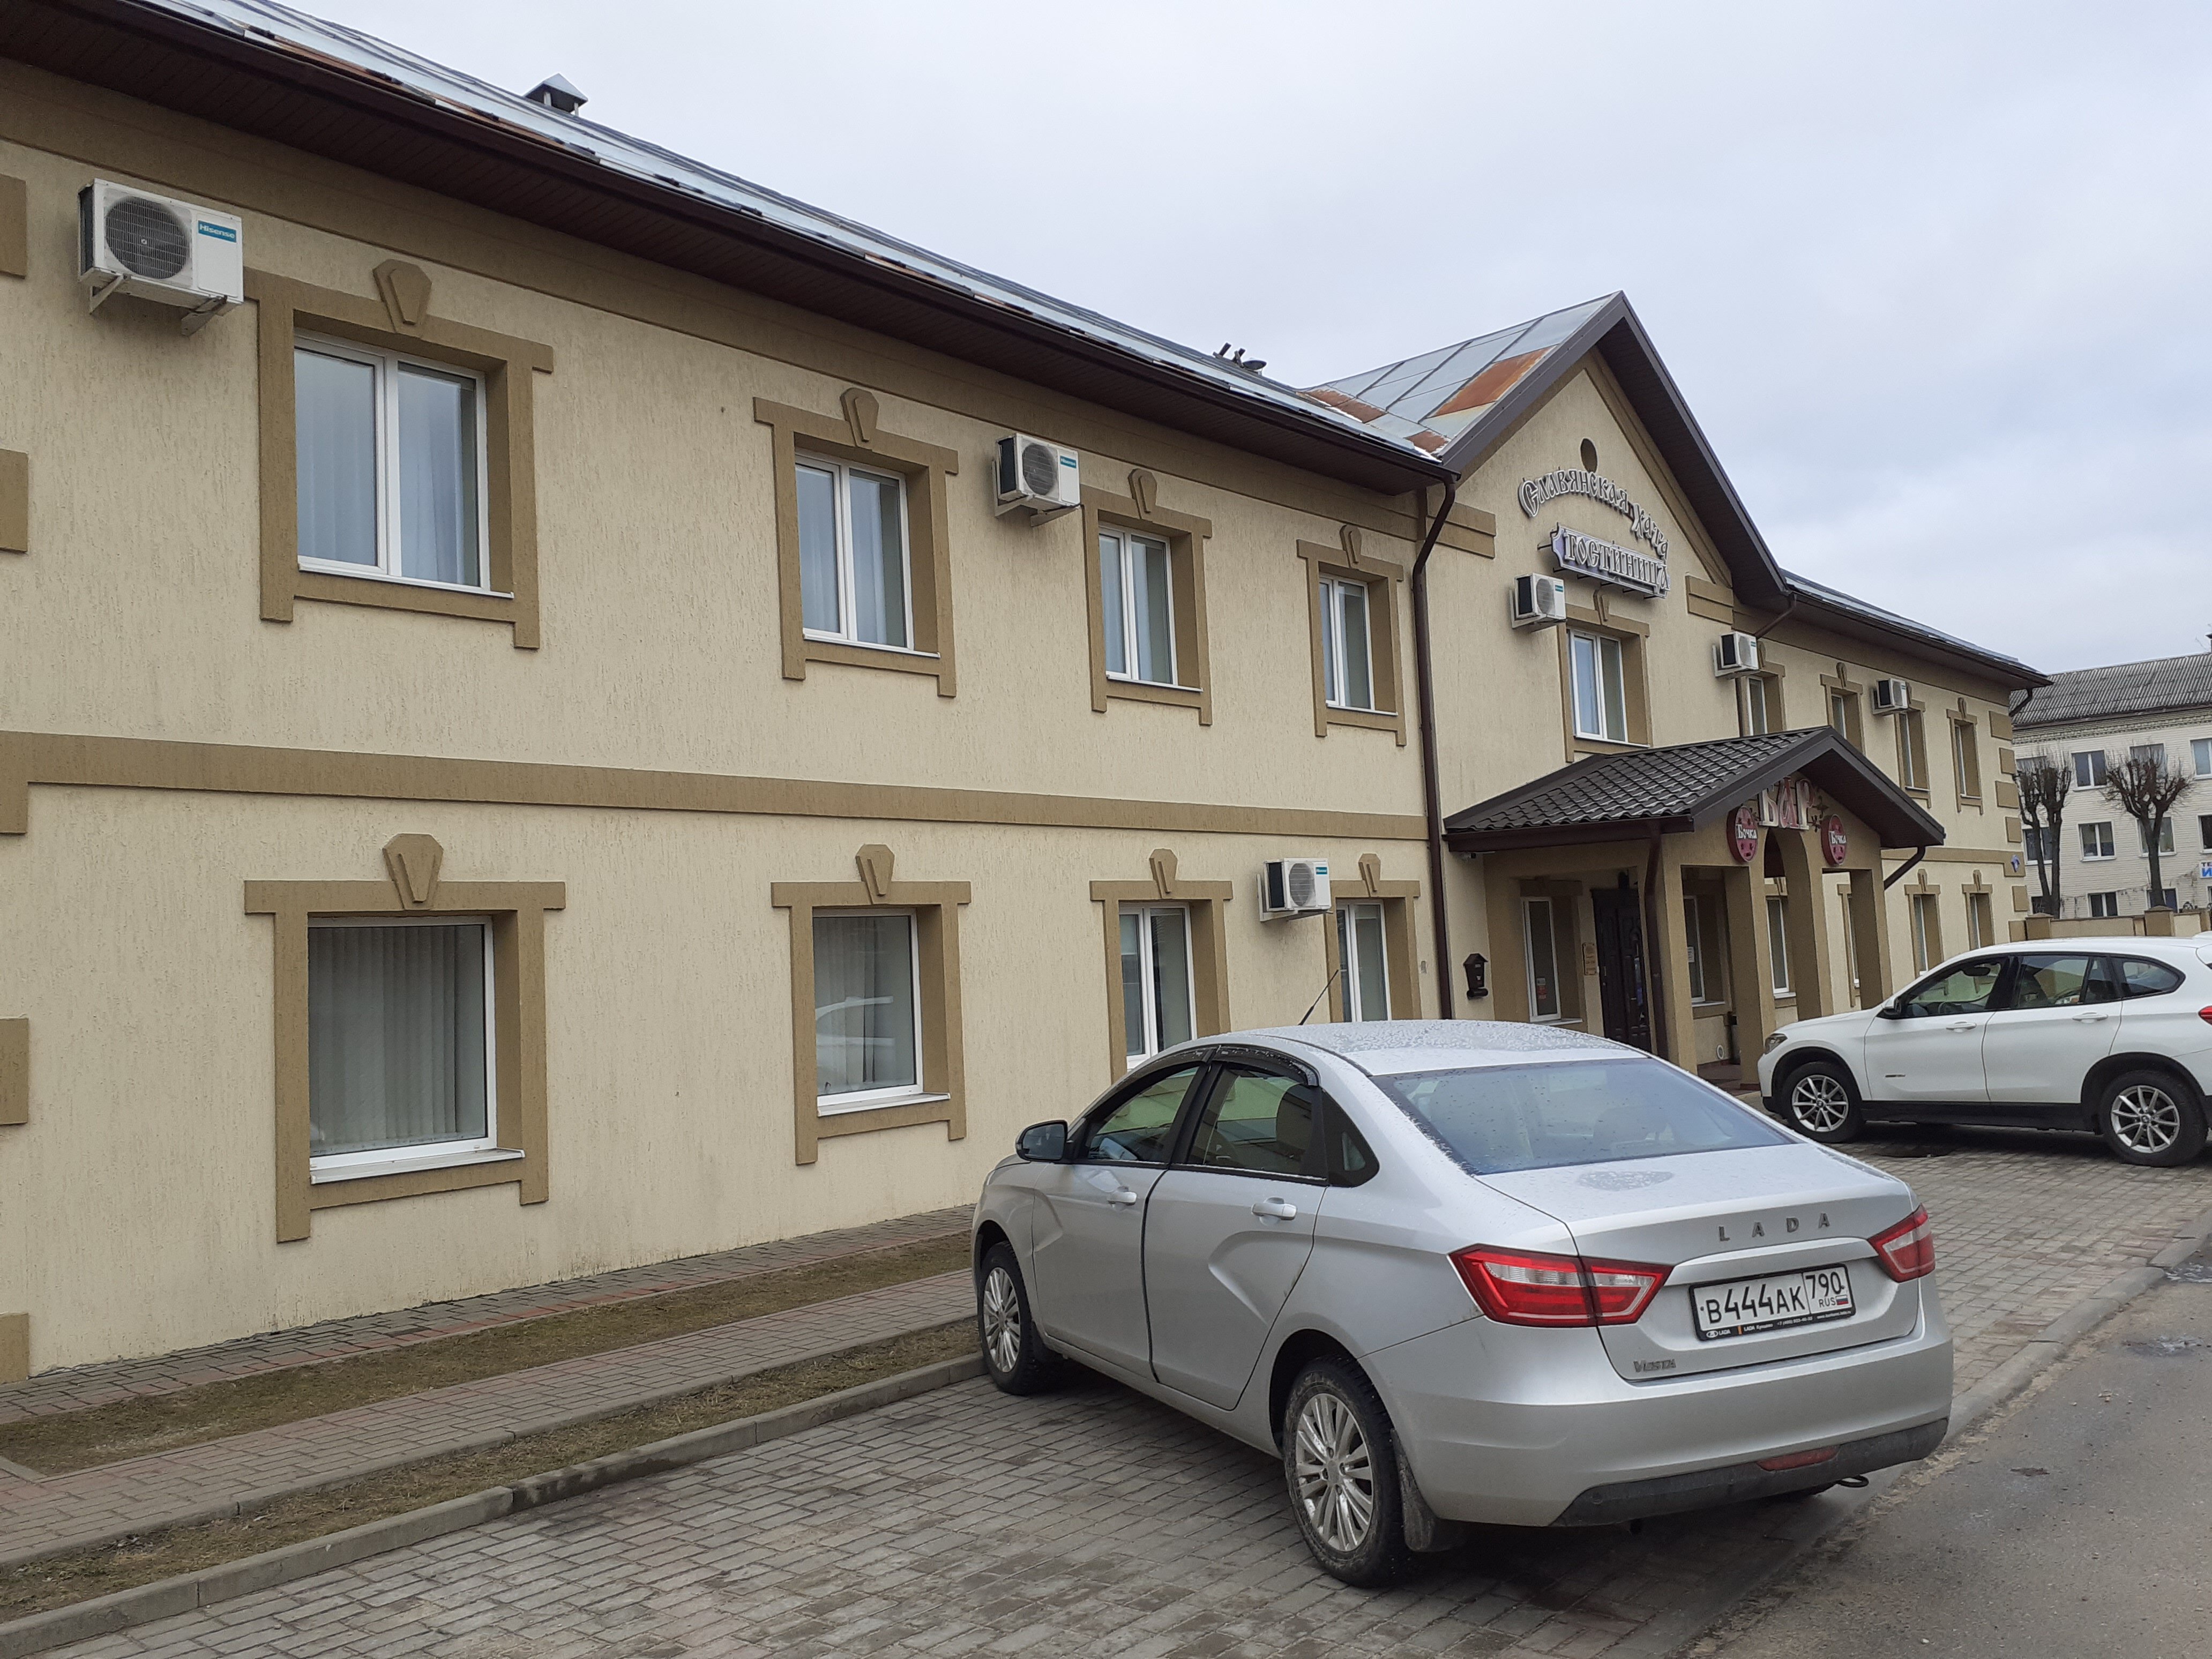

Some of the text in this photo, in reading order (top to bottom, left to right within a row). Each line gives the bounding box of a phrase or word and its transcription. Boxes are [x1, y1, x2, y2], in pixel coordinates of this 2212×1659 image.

[199, 224, 235, 239] Hisense
[1564, 530, 1670, 595] ГОСТИНИЦА
[1737, 825, 1757, 839] Бочка
[1830, 831, 1847, 844] Бочка
[1718, 1213, 1830, 1242] LADA
[1805, 1272, 1842, 1299] 790
[1818, 1297, 1836, 1308] RUS
